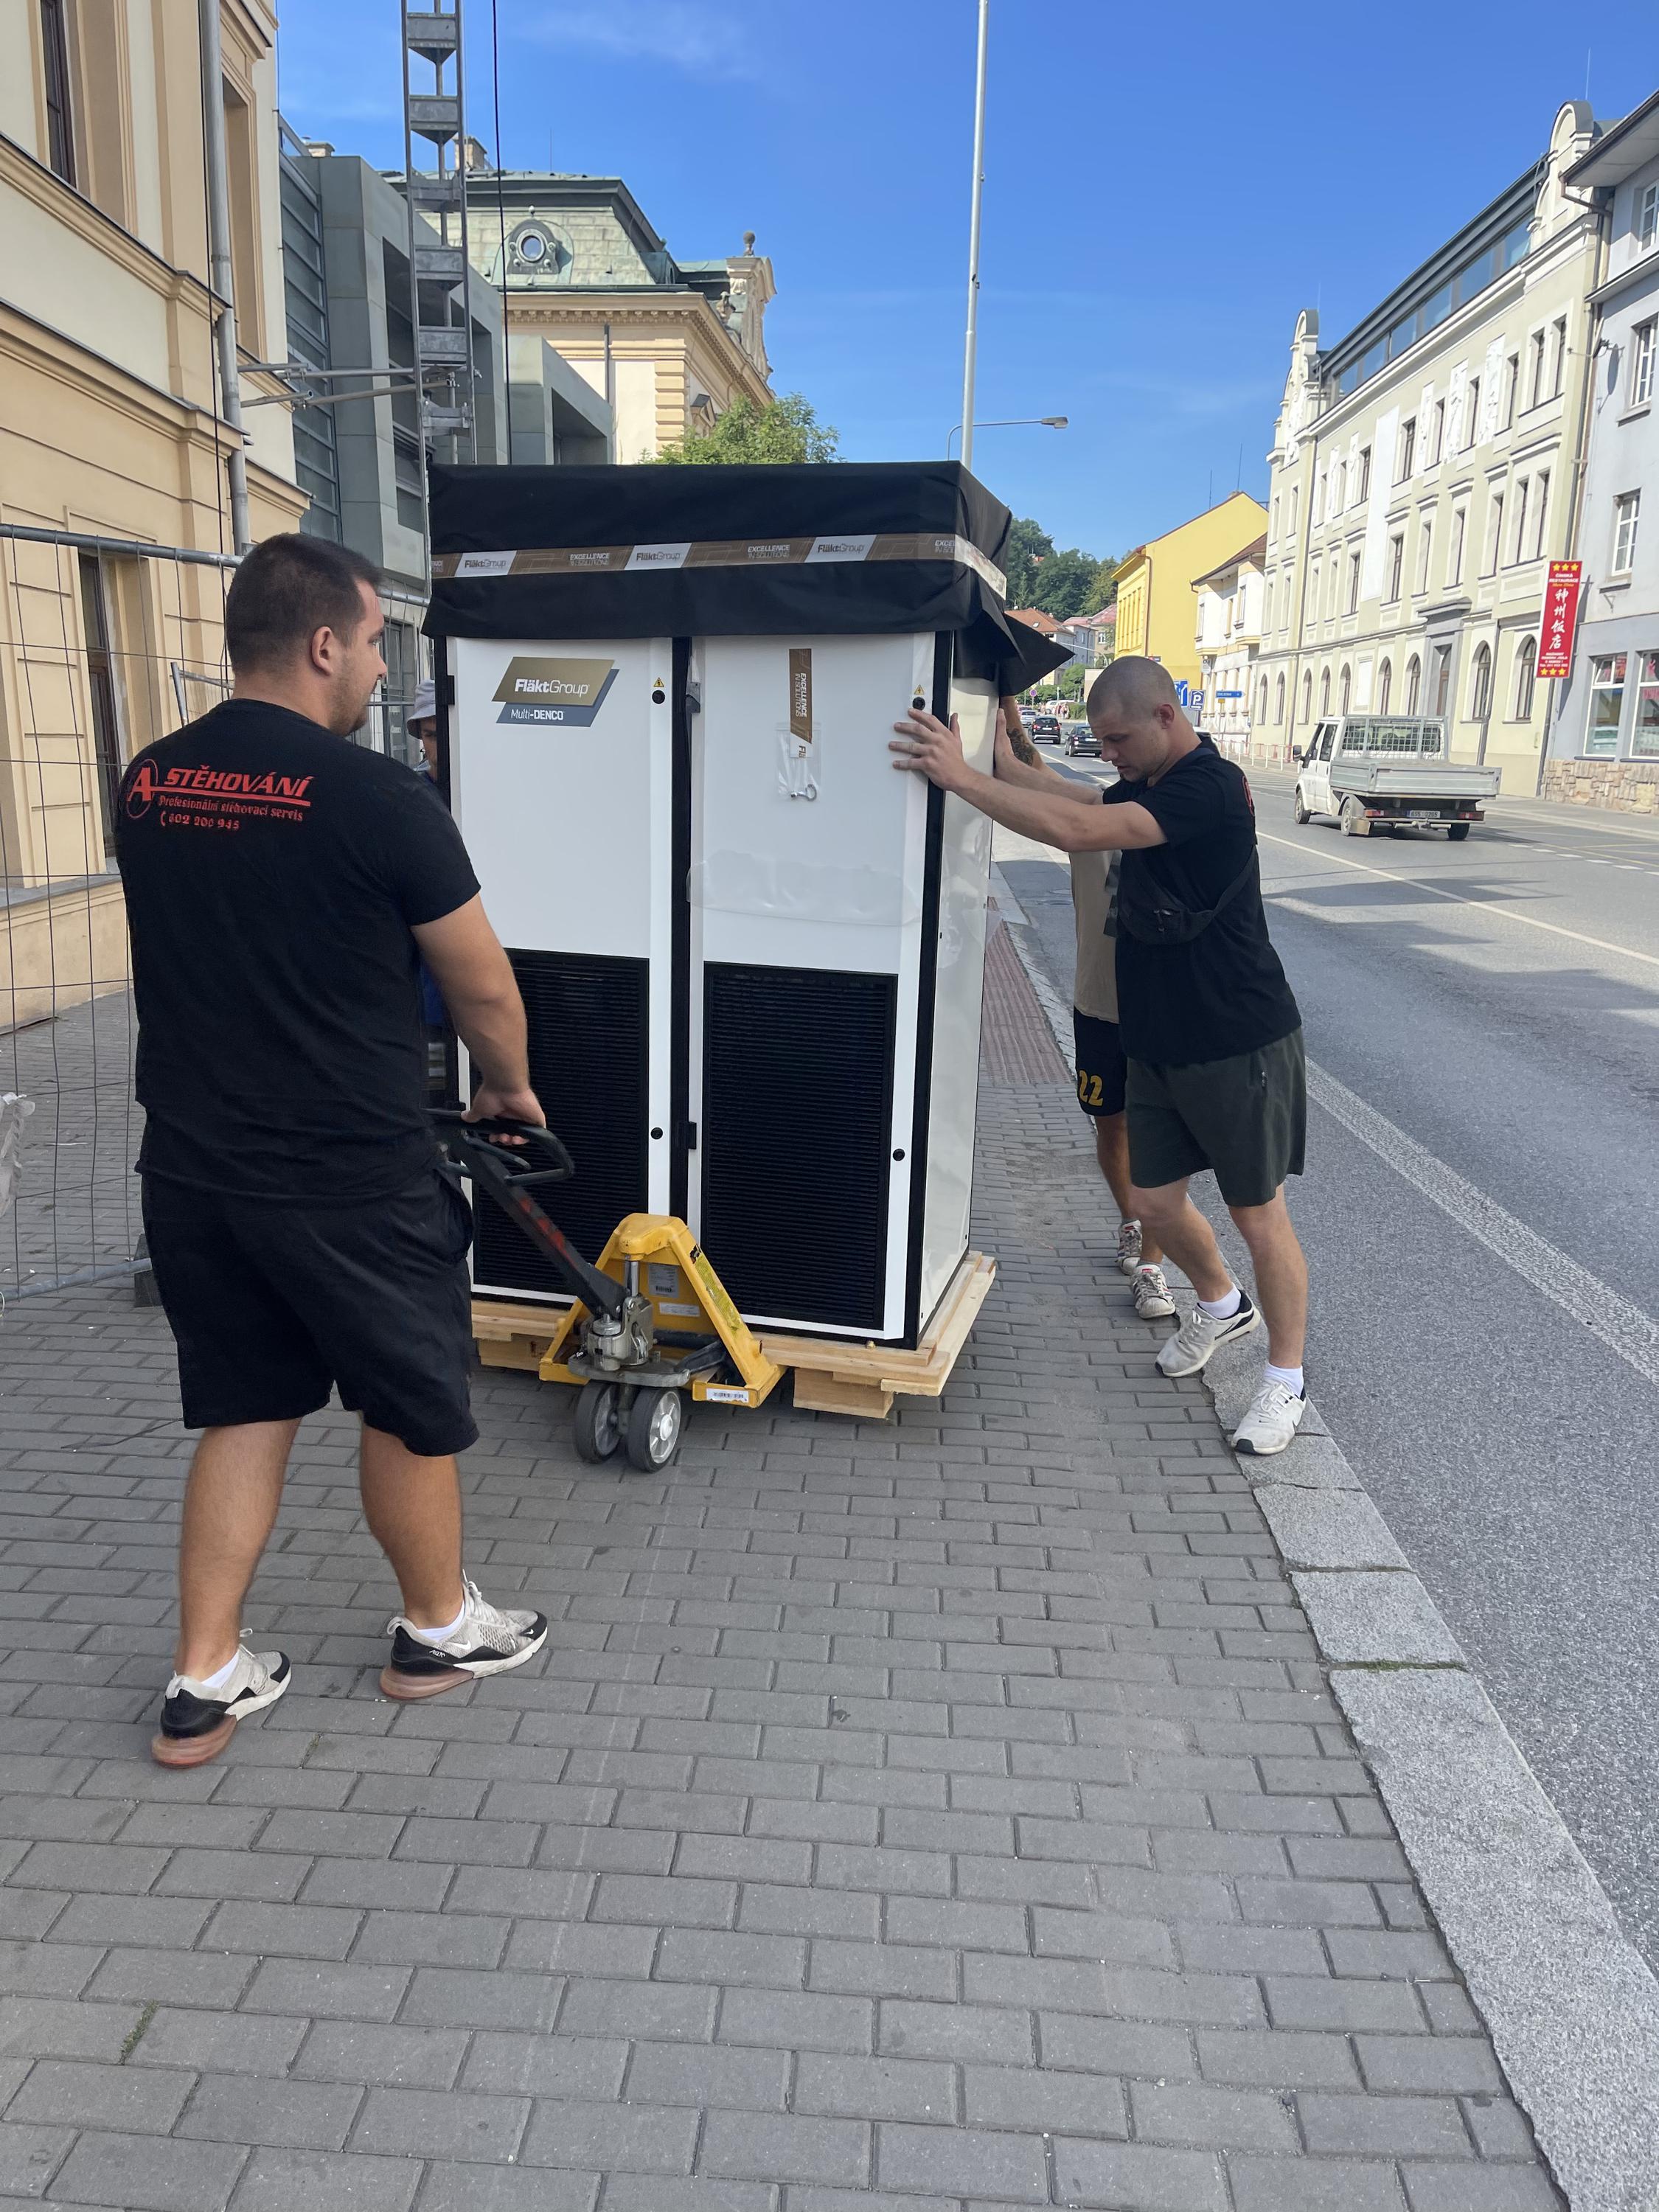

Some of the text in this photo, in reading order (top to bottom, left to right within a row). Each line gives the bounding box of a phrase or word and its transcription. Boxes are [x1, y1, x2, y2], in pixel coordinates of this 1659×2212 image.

[748, 544, 790, 553] EXCELLENCE
[818, 543, 866, 553] FläktGroup
[636, 552, 680, 561] FläktGroup
[1549, 588, 1569, 650] 神州饭店
[515, 678, 590, 698] FläktGroup
[1192, 695, 1202, 706] P
[511, 709, 564, 720] Multi-DENCO
[164, 764, 315, 797] STĚHOVÁNÍ
[270, 807, 304, 822] servis
[1079, 1069, 1104, 1106] 22
